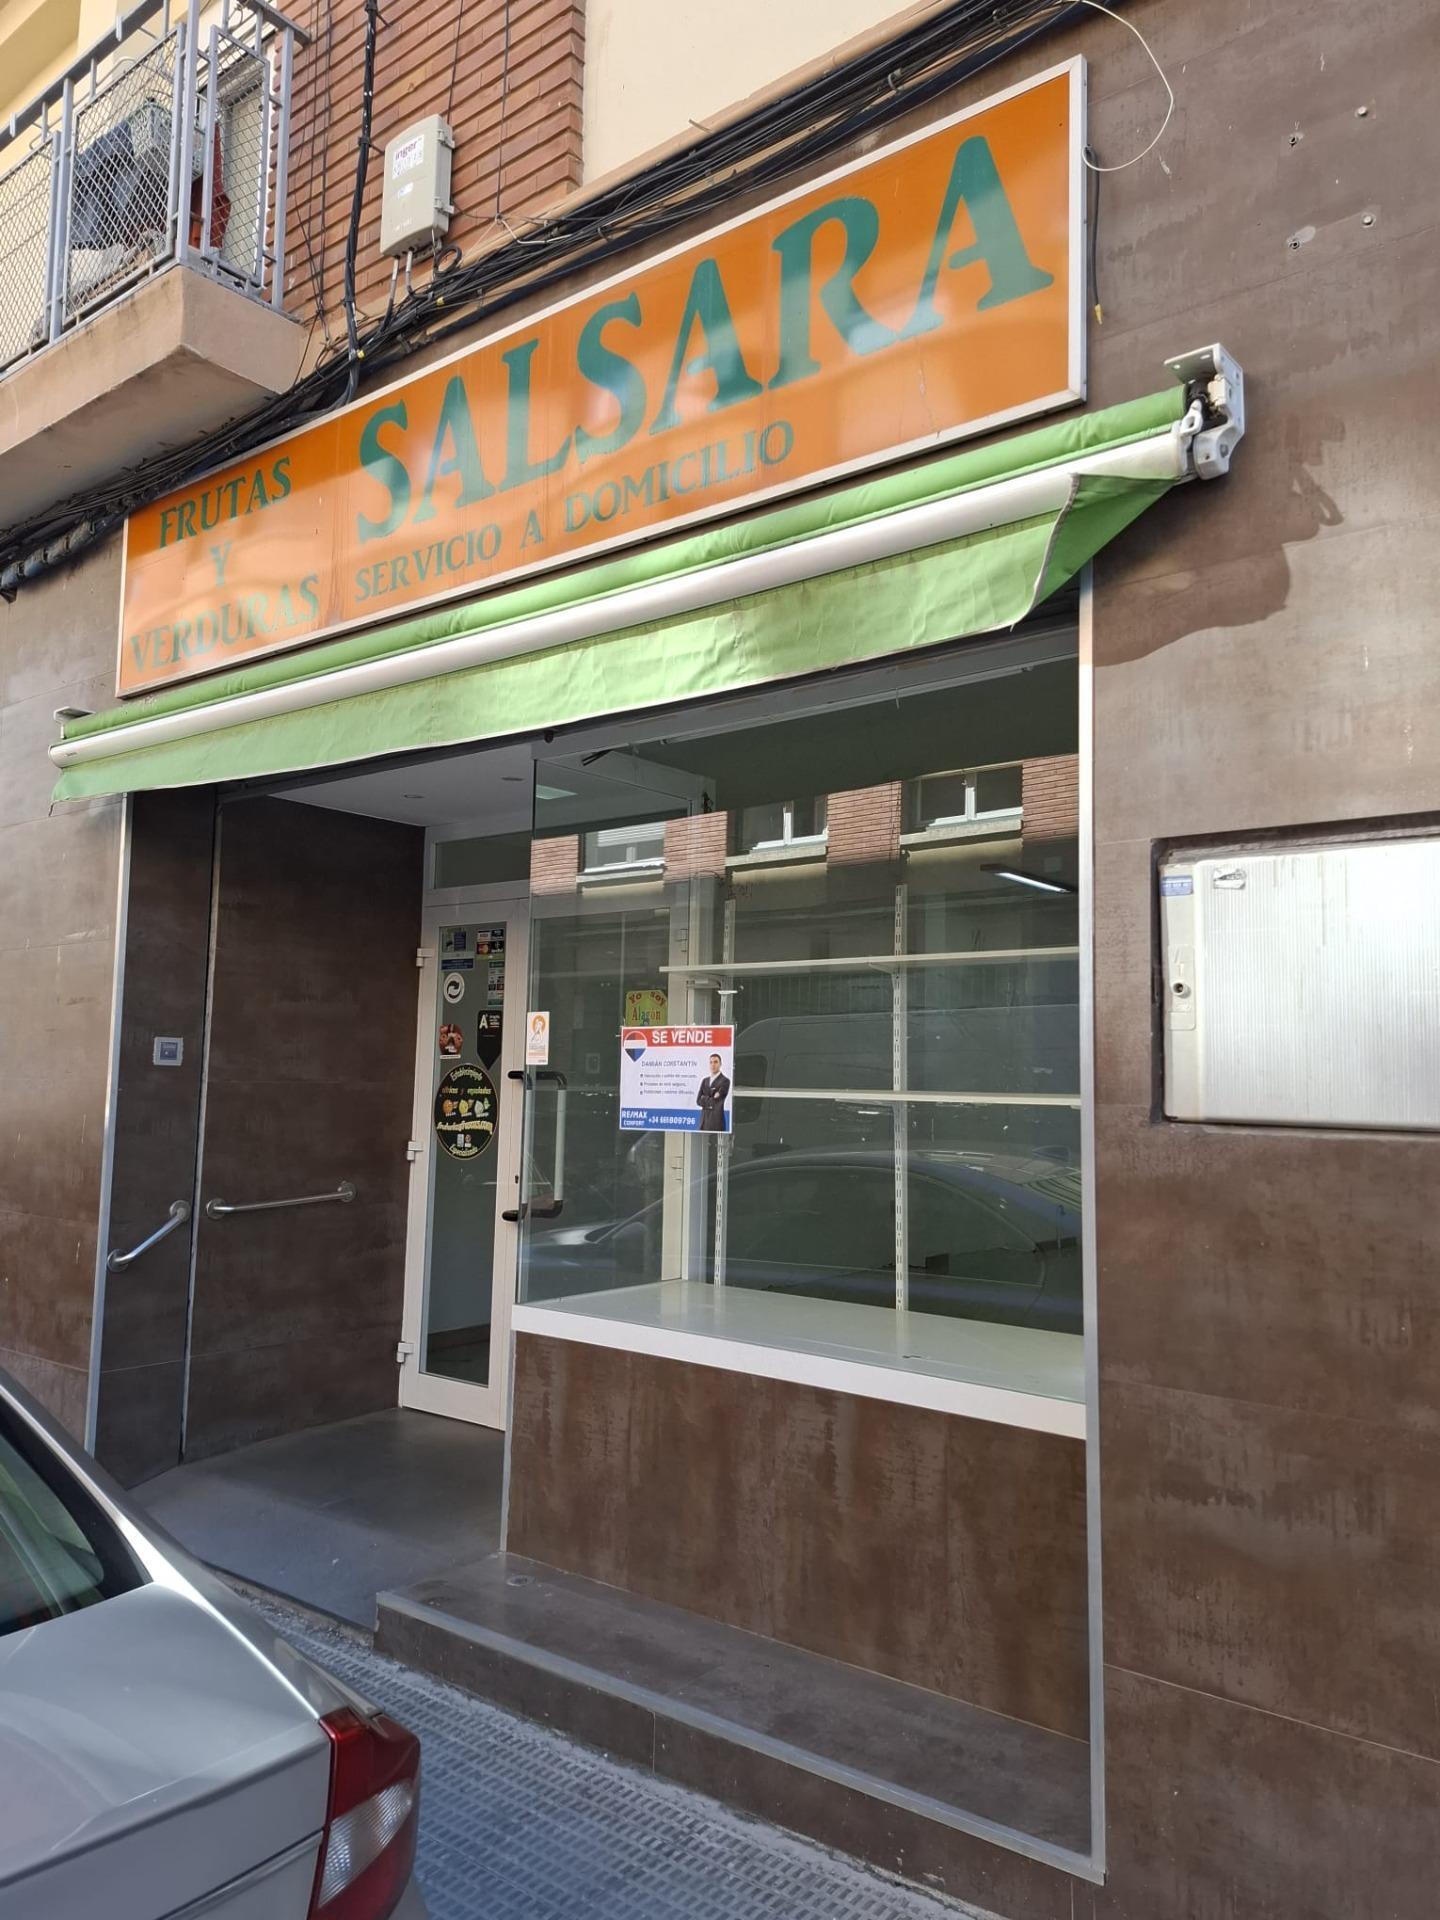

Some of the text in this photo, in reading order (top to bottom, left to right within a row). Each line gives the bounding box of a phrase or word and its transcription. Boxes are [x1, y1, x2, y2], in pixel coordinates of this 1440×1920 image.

[356, 134, 1055, 544] SALSARA
[159, 456, 292, 548] FRUTAS
[355, 420, 794, 602] SERVICIO A DOMICILIO
[208, 538, 233, 587] Y
[130, 572, 320, 673] VERDURAS
[652, 1030, 713, 1044] SE VENDE
[621, 1110, 648, 1119] RE/MAX
